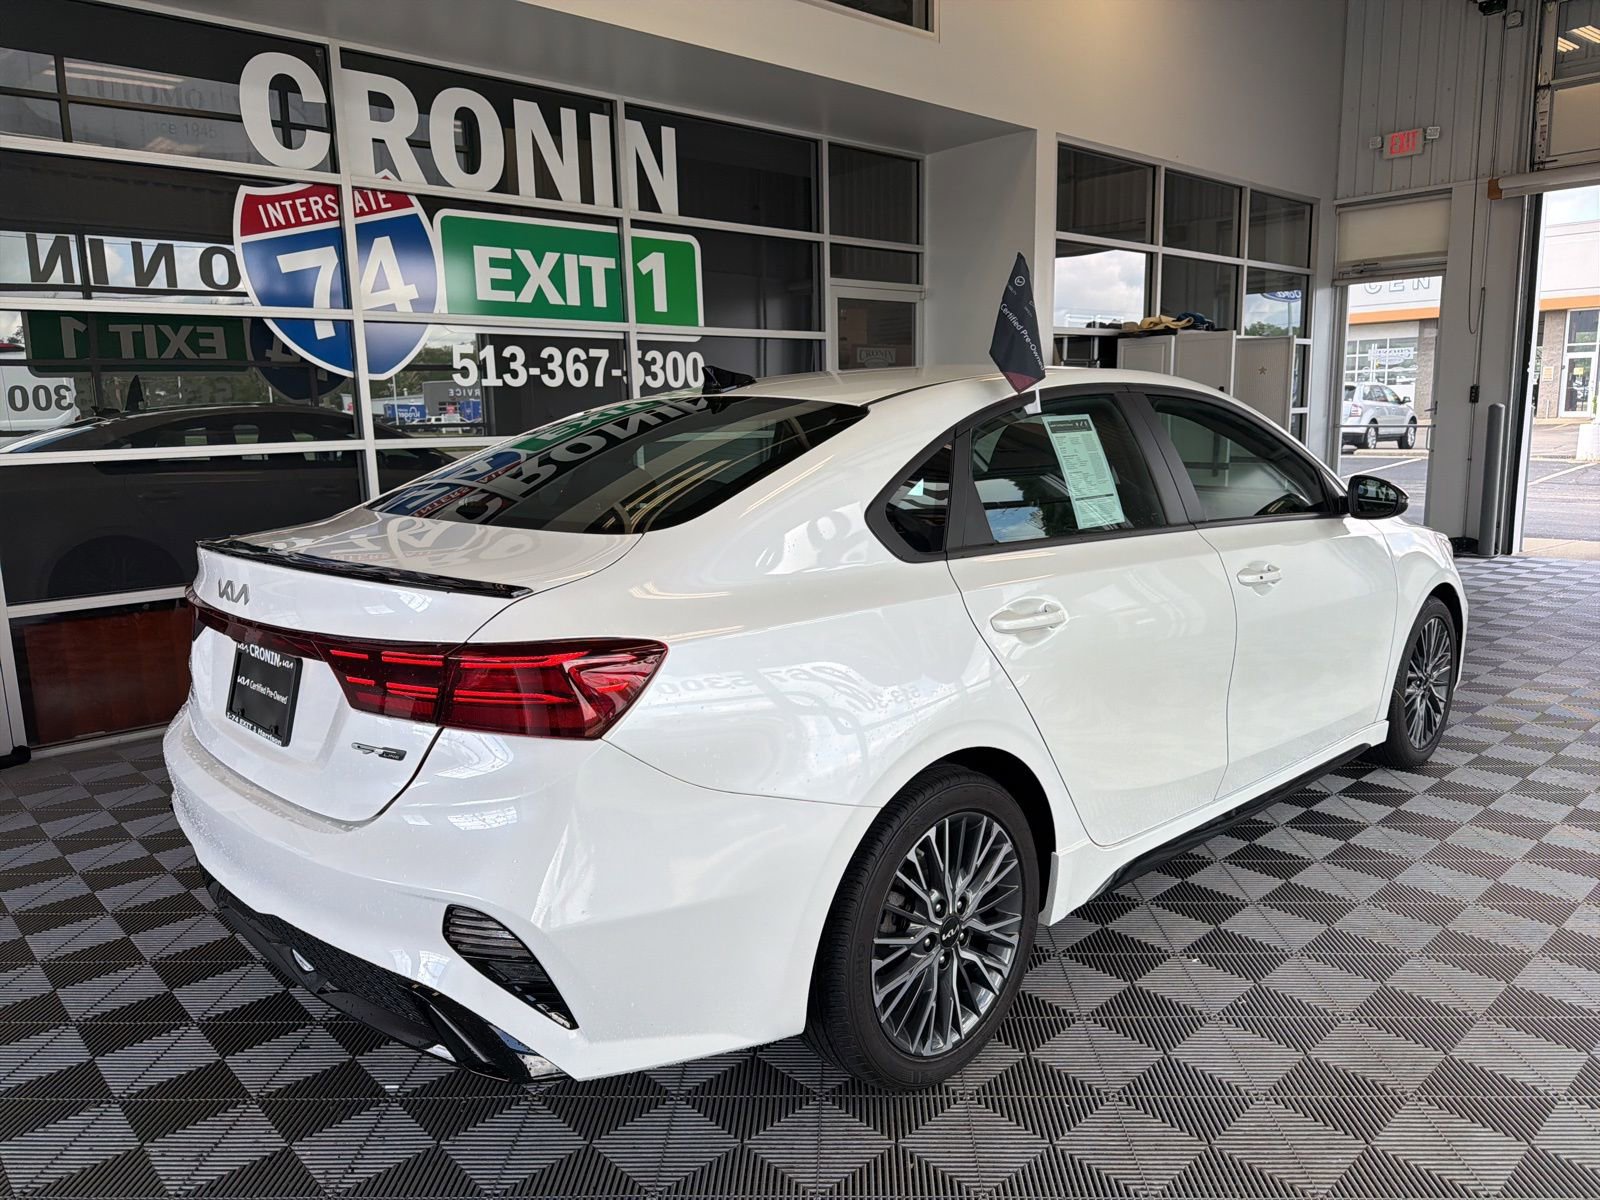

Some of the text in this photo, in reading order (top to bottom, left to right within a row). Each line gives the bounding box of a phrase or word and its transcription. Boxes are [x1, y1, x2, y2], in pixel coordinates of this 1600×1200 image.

[239, 52, 680, 216] CRONIN
[1391, 130, 1417, 155] EXIT
[258, 190, 392, 229] INTERSATE
[277, 236, 420, 340] 74
[472, 245, 668, 313] EXIT 1
[1000, 303, 1023, 331] Certified
[451, 344, 706, 389] 513-367-5300
[218, 577, 249, 605] KIA
[249, 644, 280, 667] CRONIN
[250, 680, 267, 695] Certified
[266, 687, 288, 705] Pre-Owned
[258, 728, 282, 746] Harrison
[942, 926, 960, 940] KIA
